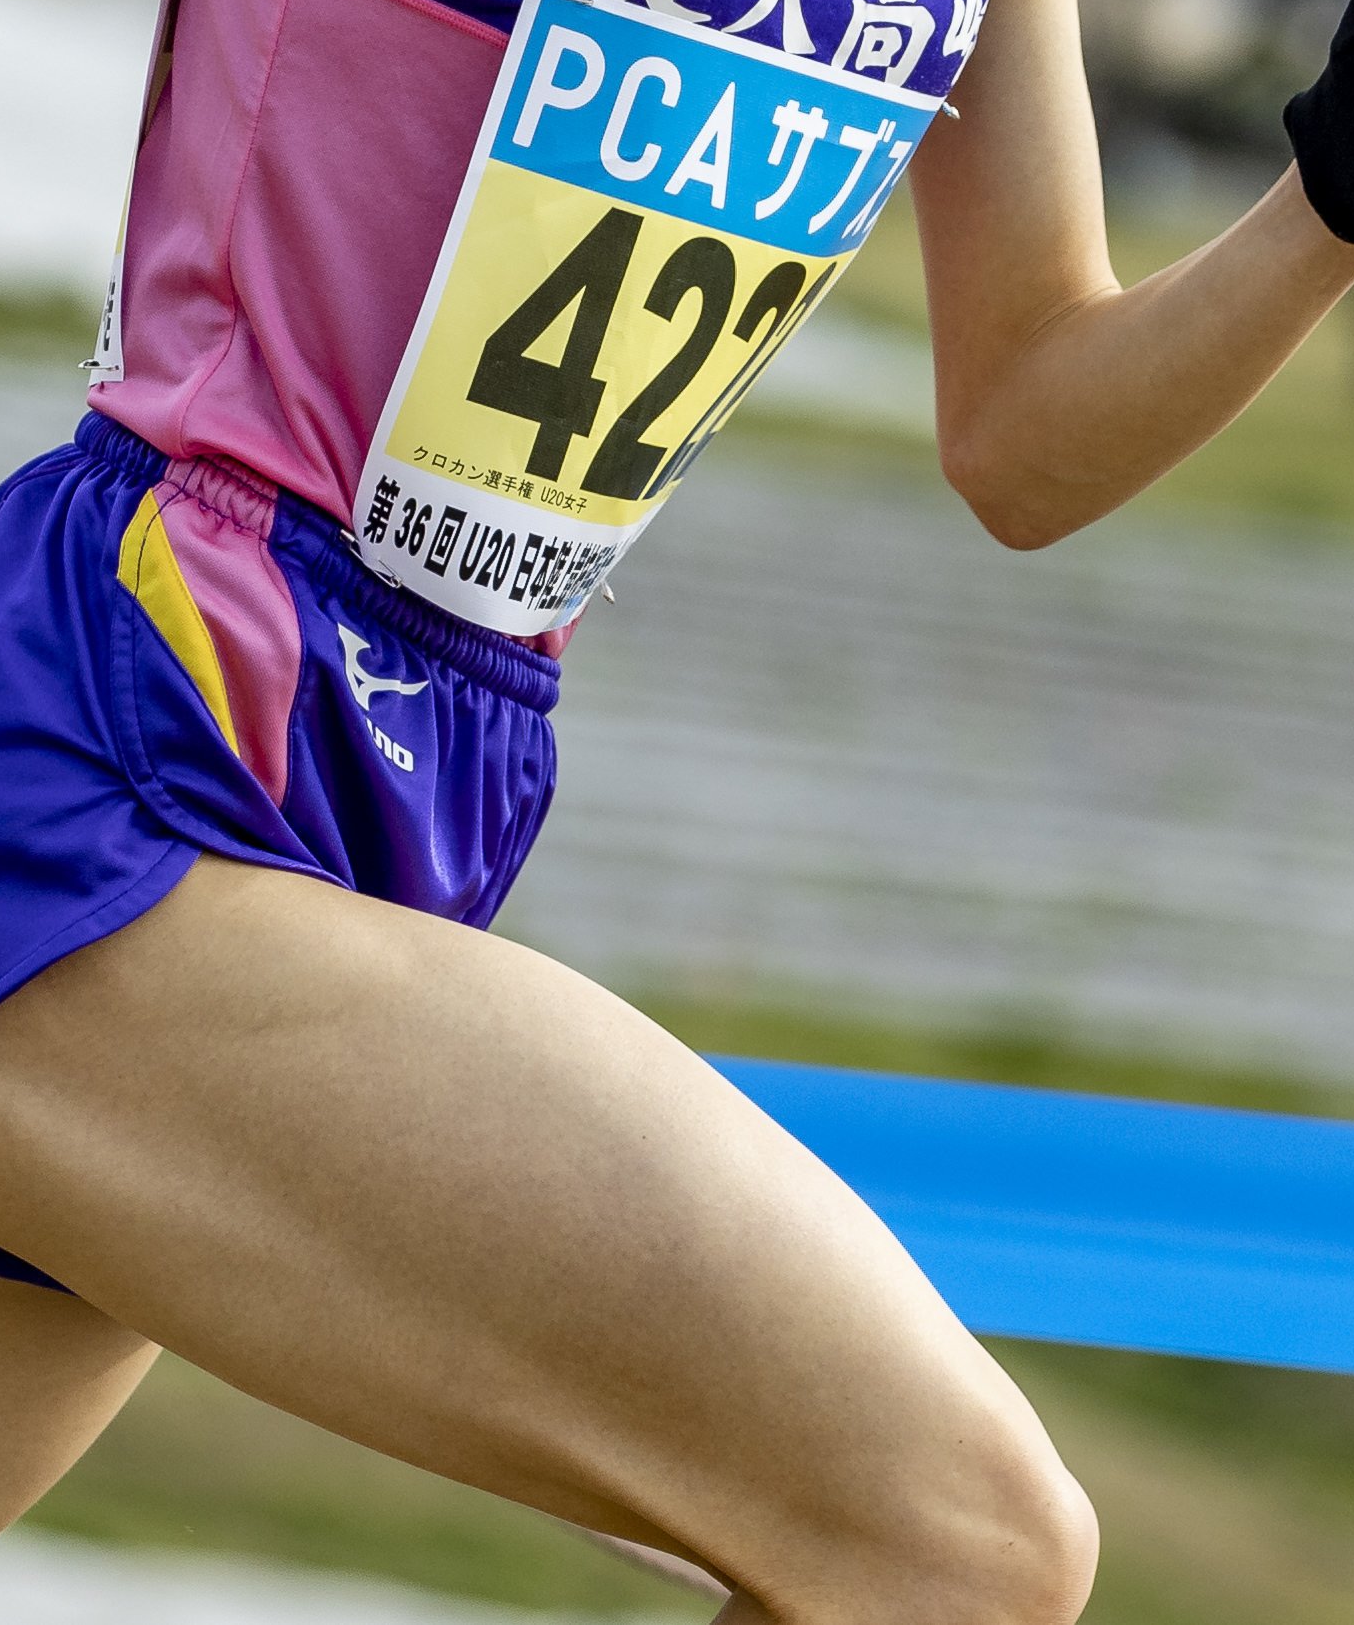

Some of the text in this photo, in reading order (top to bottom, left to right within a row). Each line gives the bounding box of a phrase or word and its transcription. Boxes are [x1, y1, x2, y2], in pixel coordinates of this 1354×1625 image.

[512, 25, 913, 239] PCAサブス
[413, 445, 588, 514] クロカン選手権 U20女子
